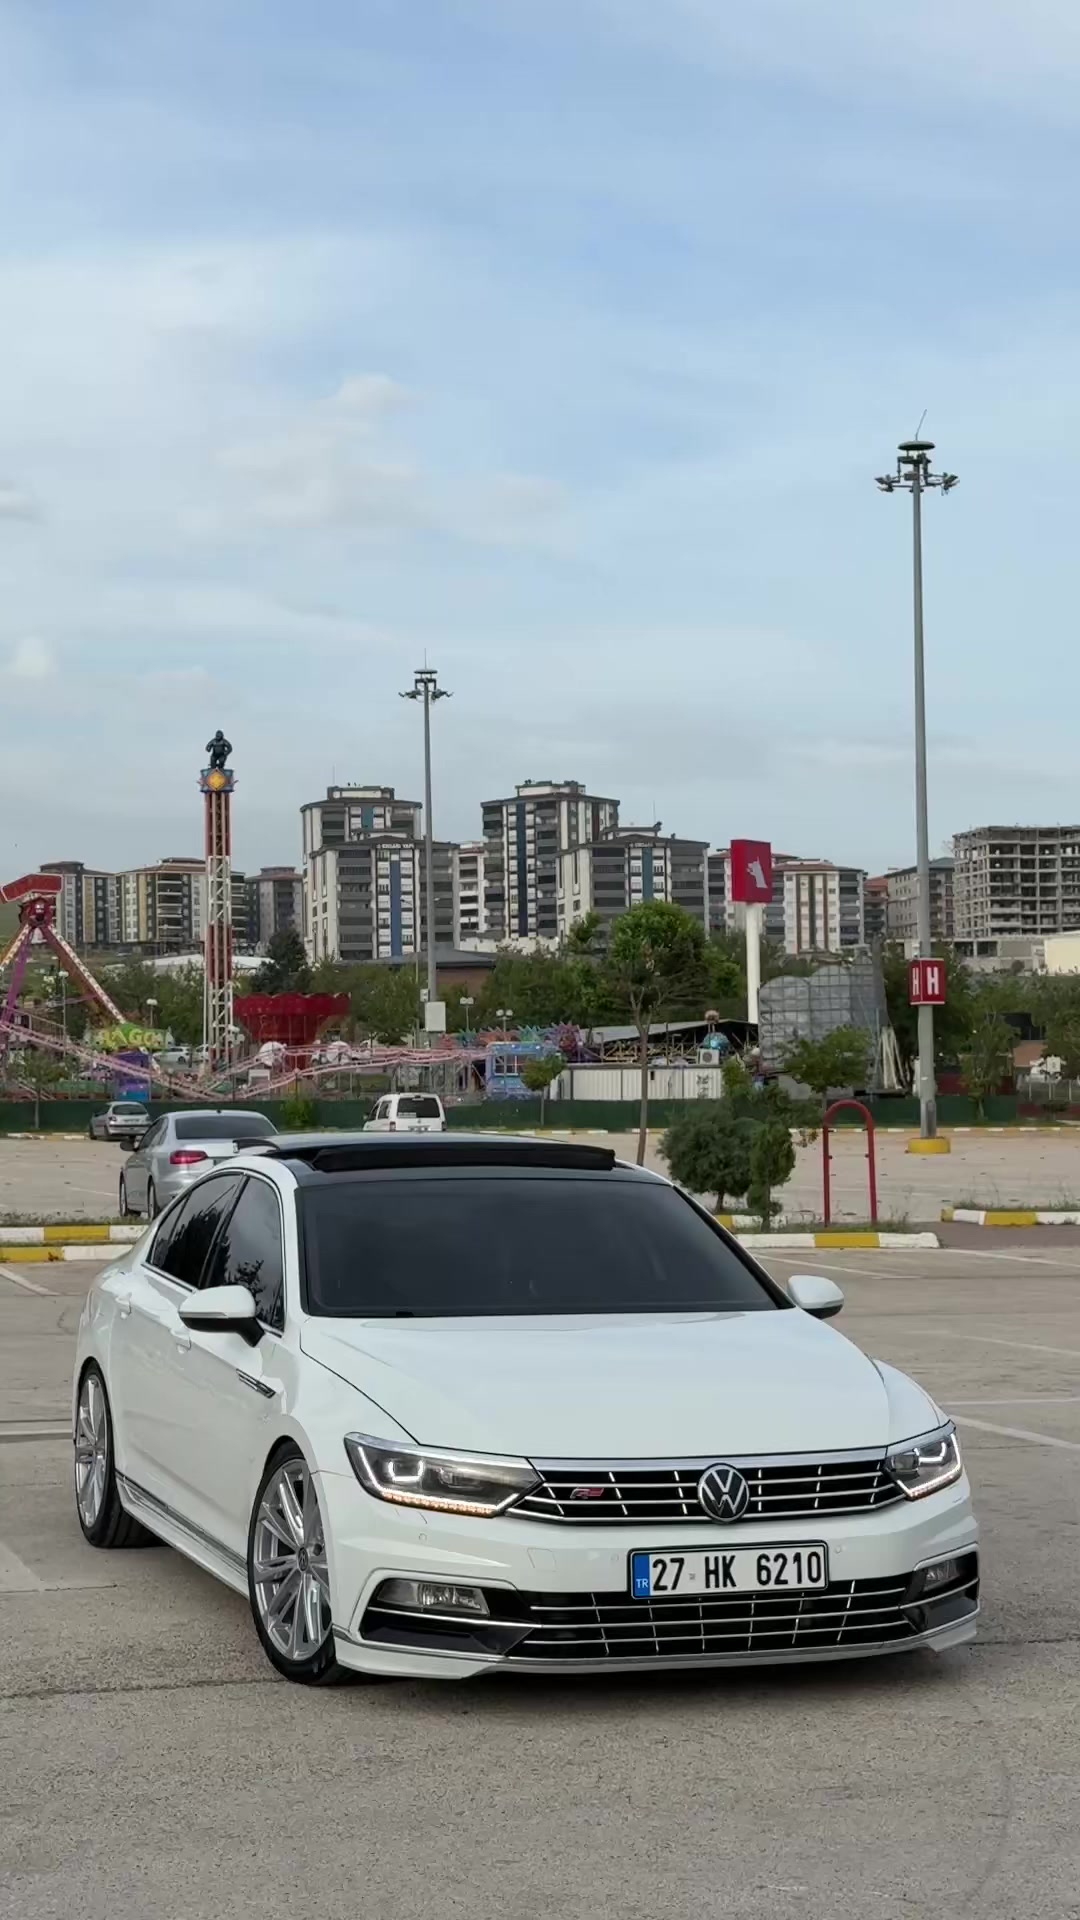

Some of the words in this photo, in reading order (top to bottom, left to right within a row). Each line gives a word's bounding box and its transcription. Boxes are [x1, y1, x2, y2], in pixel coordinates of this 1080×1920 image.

[912, 967, 920, 996] H
[926, 966, 939, 995] H
[699, 1464, 748, 1521] VW
[636, 1578, 648, 1588] TR
[652, 1557, 685, 1591] 27
[704, 1555, 737, 1589] HK
[756, 1551, 821, 1586] 6210
